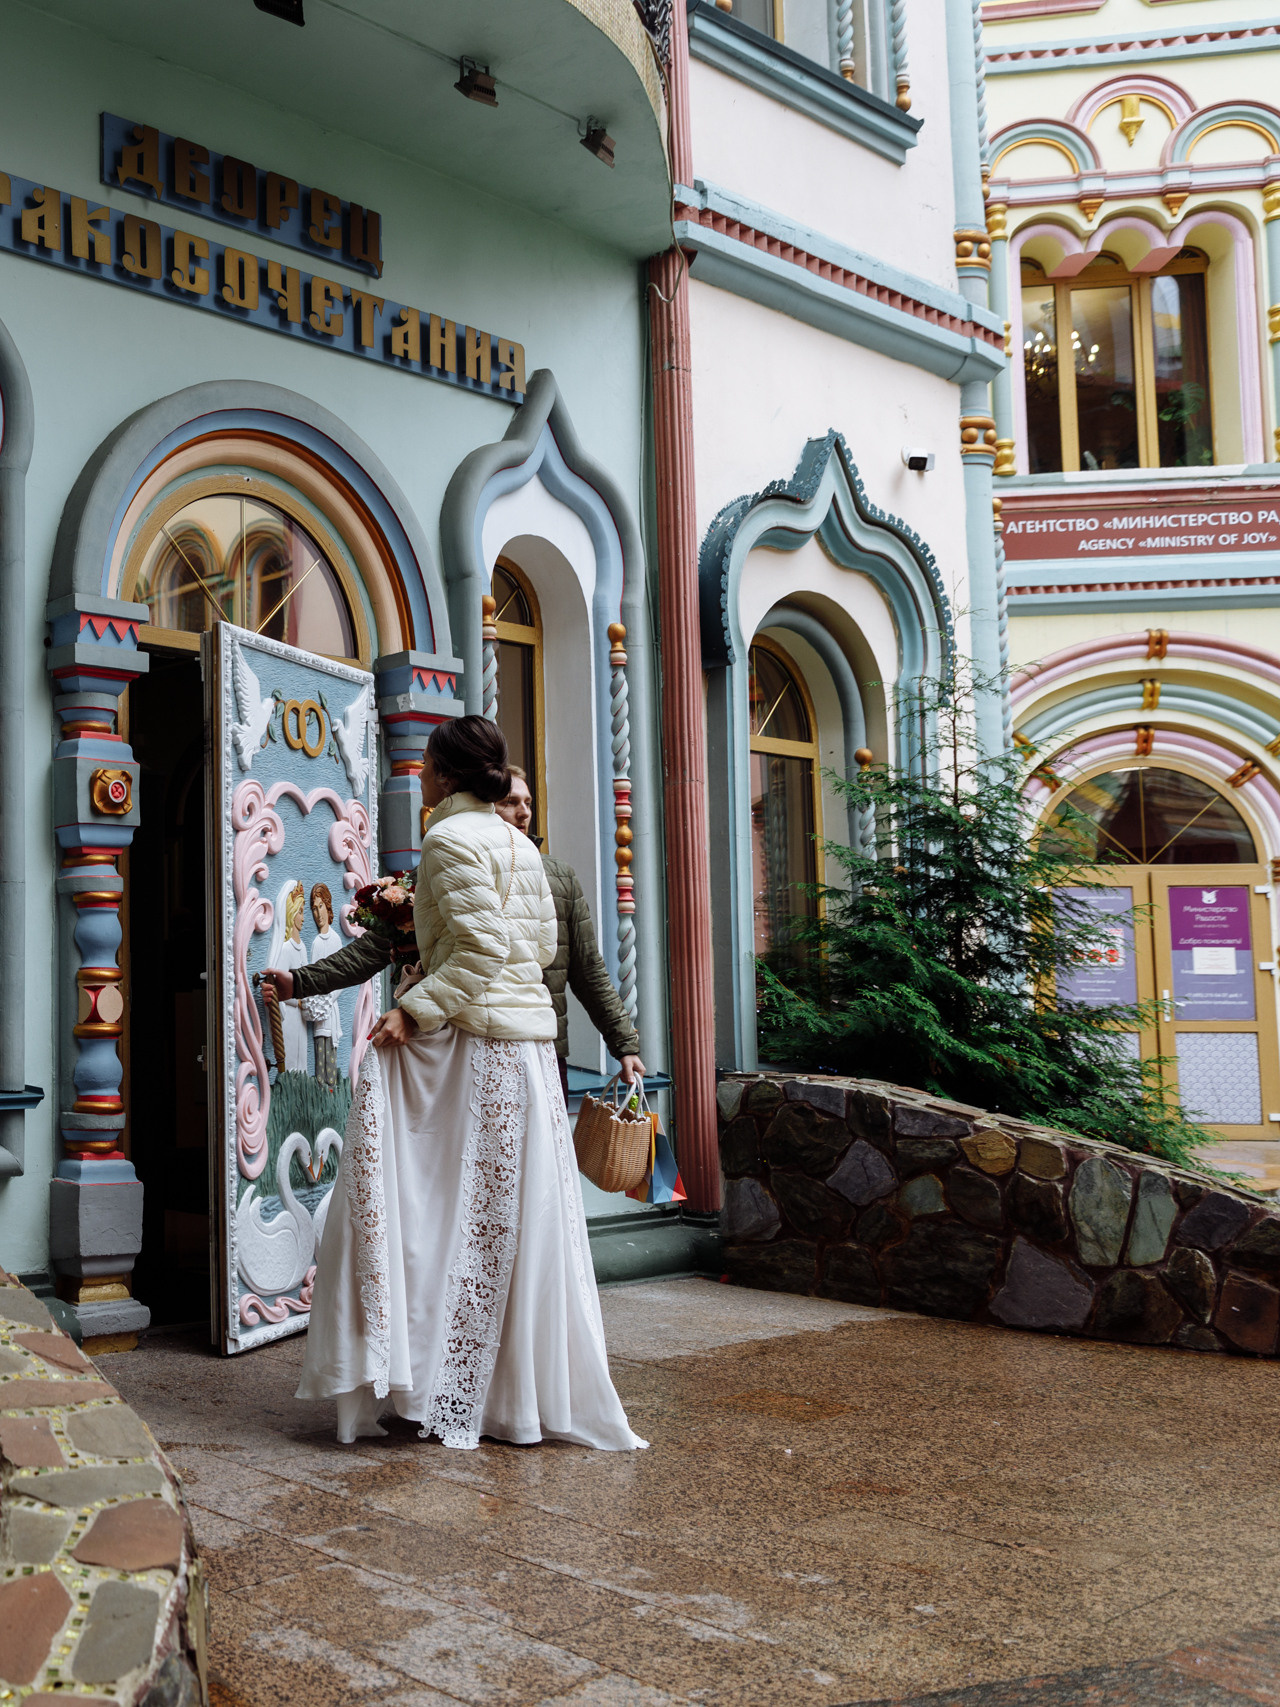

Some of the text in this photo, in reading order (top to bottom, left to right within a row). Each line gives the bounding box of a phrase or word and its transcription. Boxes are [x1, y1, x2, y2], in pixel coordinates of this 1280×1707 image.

[117, 124, 384, 277] ДВОРЕЦ
[1006, 510, 1280, 535] АГЕНТСТВО «МИНИСТЕРСТВО РА
[1077, 532, 1277, 551] AGENCY «MINISTRY OF JOY»
